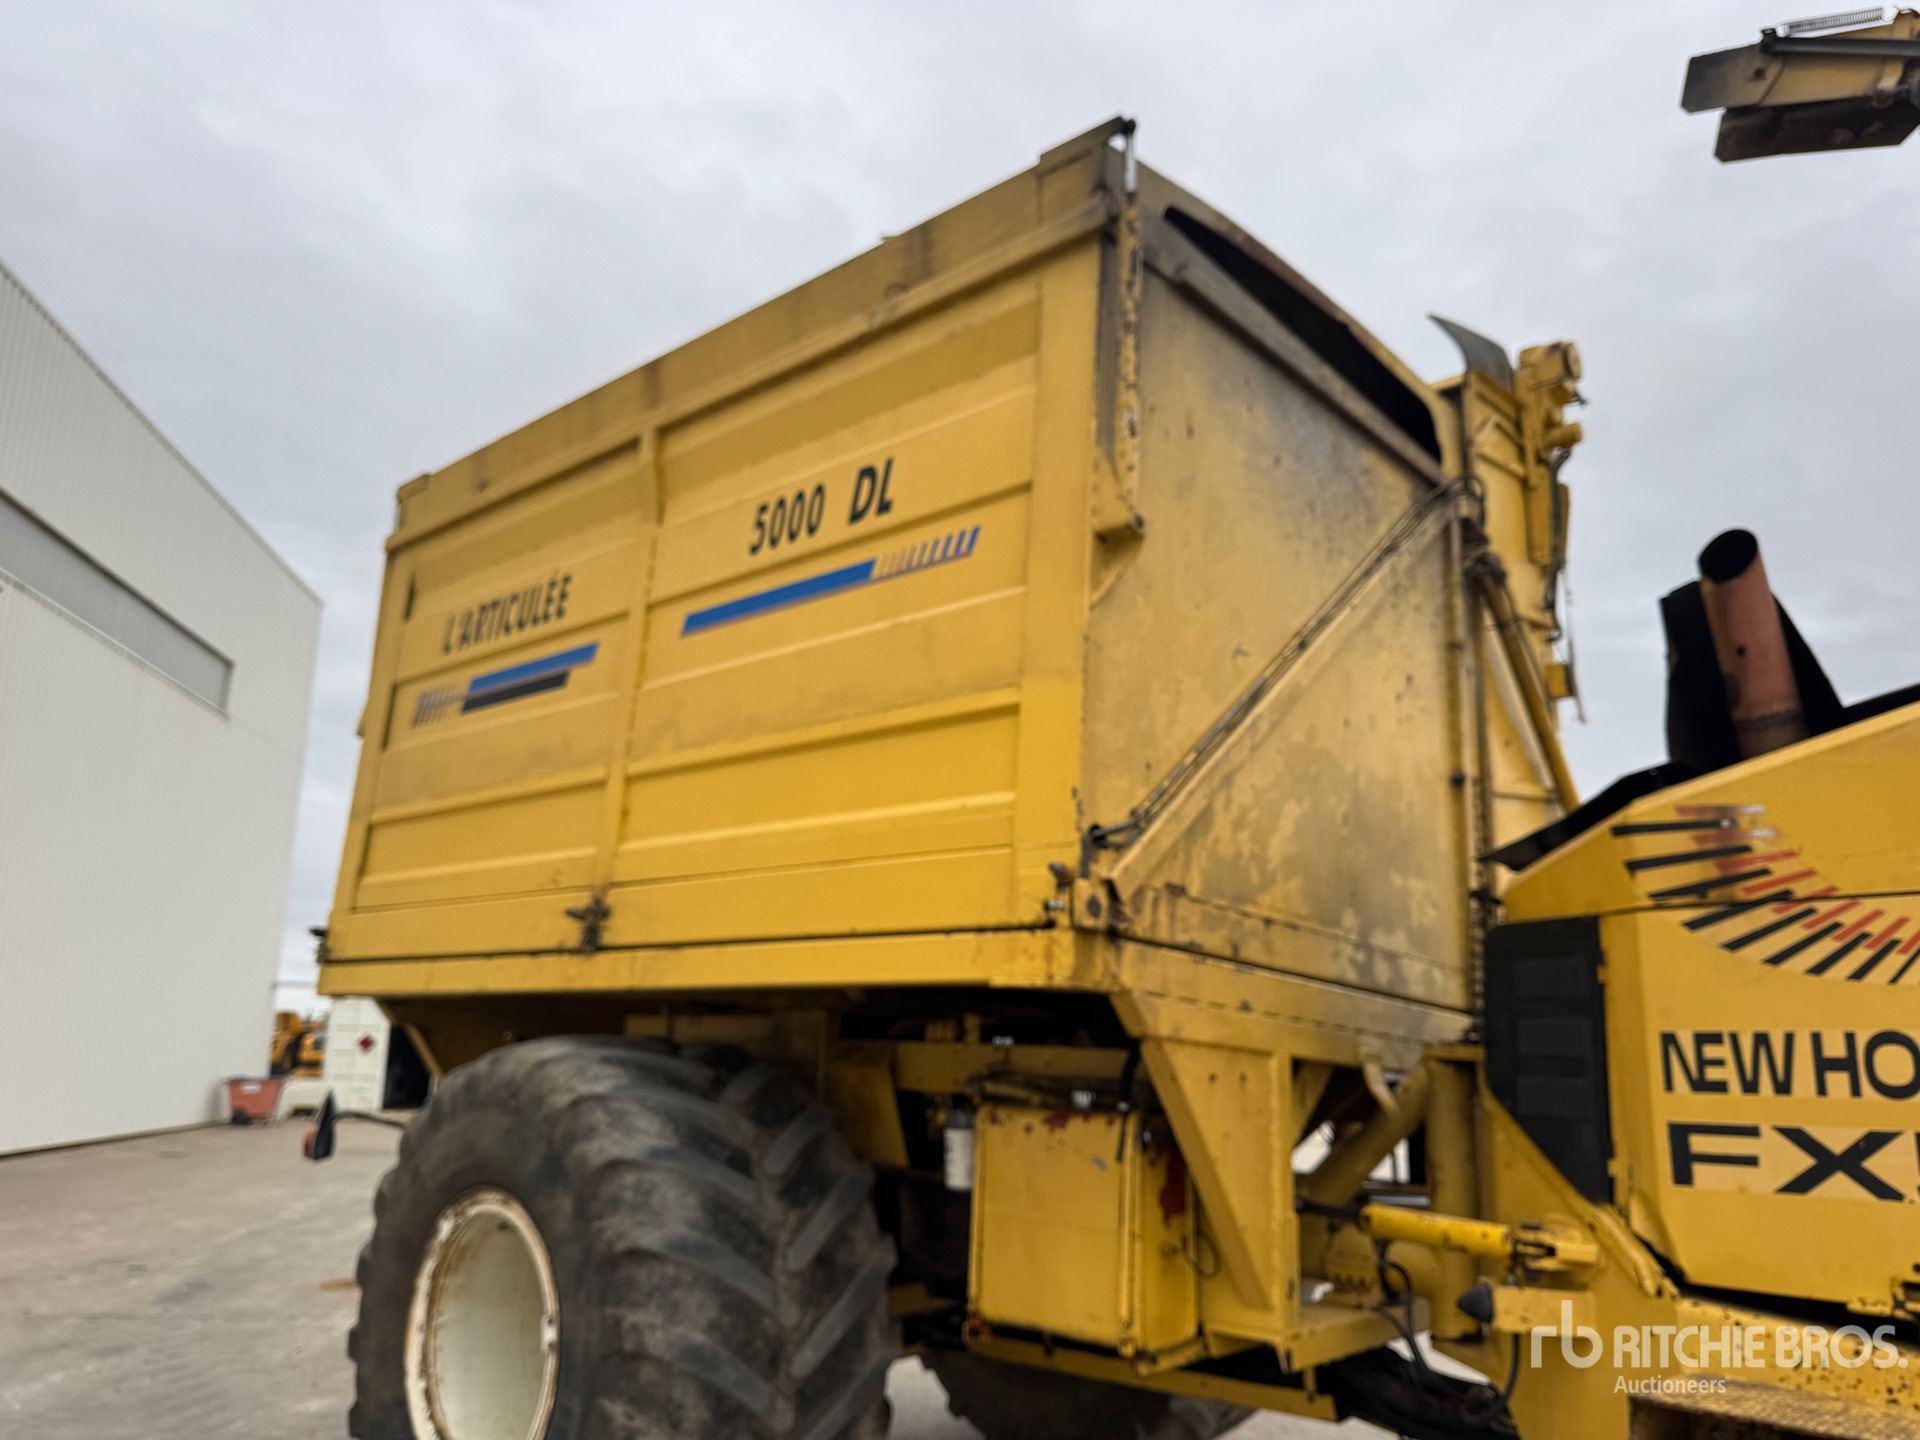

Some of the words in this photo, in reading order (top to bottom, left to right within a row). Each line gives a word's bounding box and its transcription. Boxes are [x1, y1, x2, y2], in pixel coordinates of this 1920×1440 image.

[749, 483, 825, 556] 5000
[848, 457, 894, 526] DL
[1659, 1032, 1795, 1096] NEW
[1667, 1122, 1920, 1203] FX
